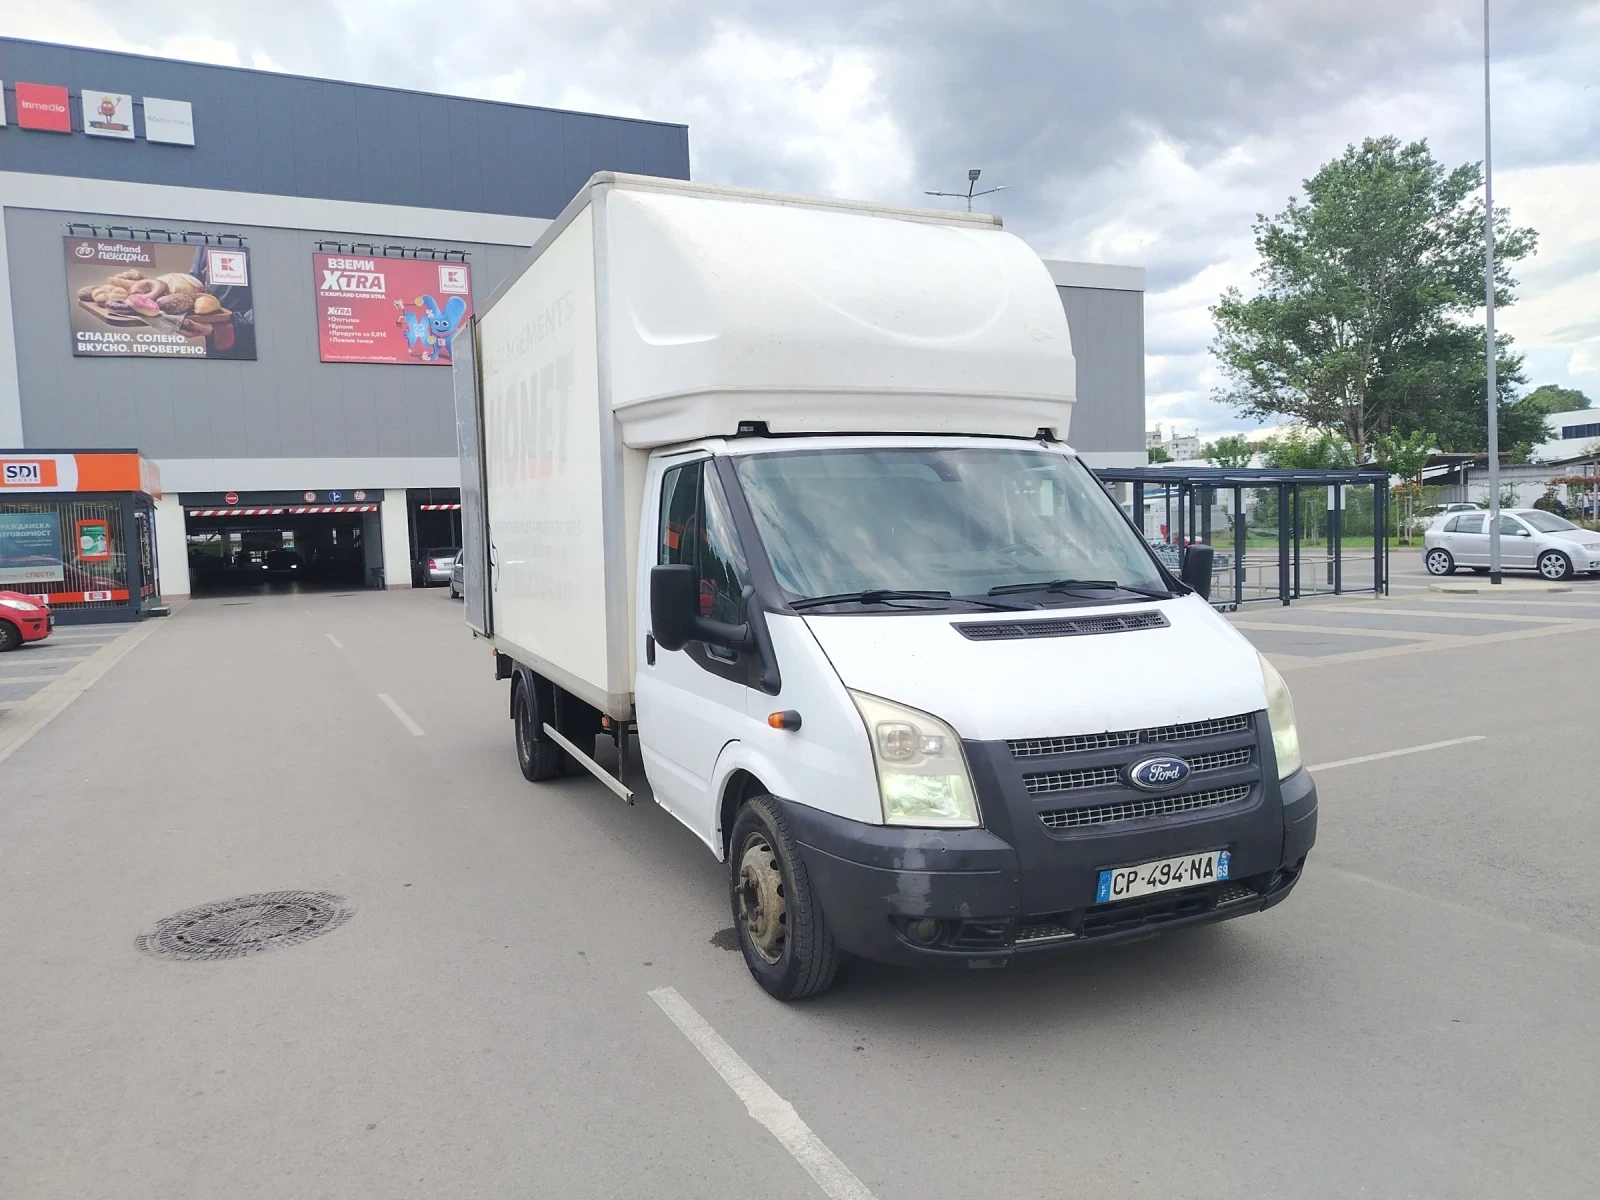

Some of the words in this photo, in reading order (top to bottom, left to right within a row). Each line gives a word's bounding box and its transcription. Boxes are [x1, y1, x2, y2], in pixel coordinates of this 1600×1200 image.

[22, 100, 66, 112] inmedio
[97, 242, 141, 254] Kaufland
[98, 250, 150, 263] пекарна
[328, 258, 374, 271] ВЗЕМИ
[320, 270, 386, 292] XTRA
[327, 307, 352, 316] XTRA
[77, 332, 133, 342] СЛАДКО.
[136, 333, 188, 344] СОЛЕНО.
[78, 343, 130, 353] ВКУСНО.
[133, 344, 206, 354] ПРОВЕРЕНО.
[6, 466, 37, 478] SDI
[1148, 763, 1180, 782] Ford
[1113, 857, 1213, 895] CP-494-NA
[1218, 864, 1228, 877] 69
